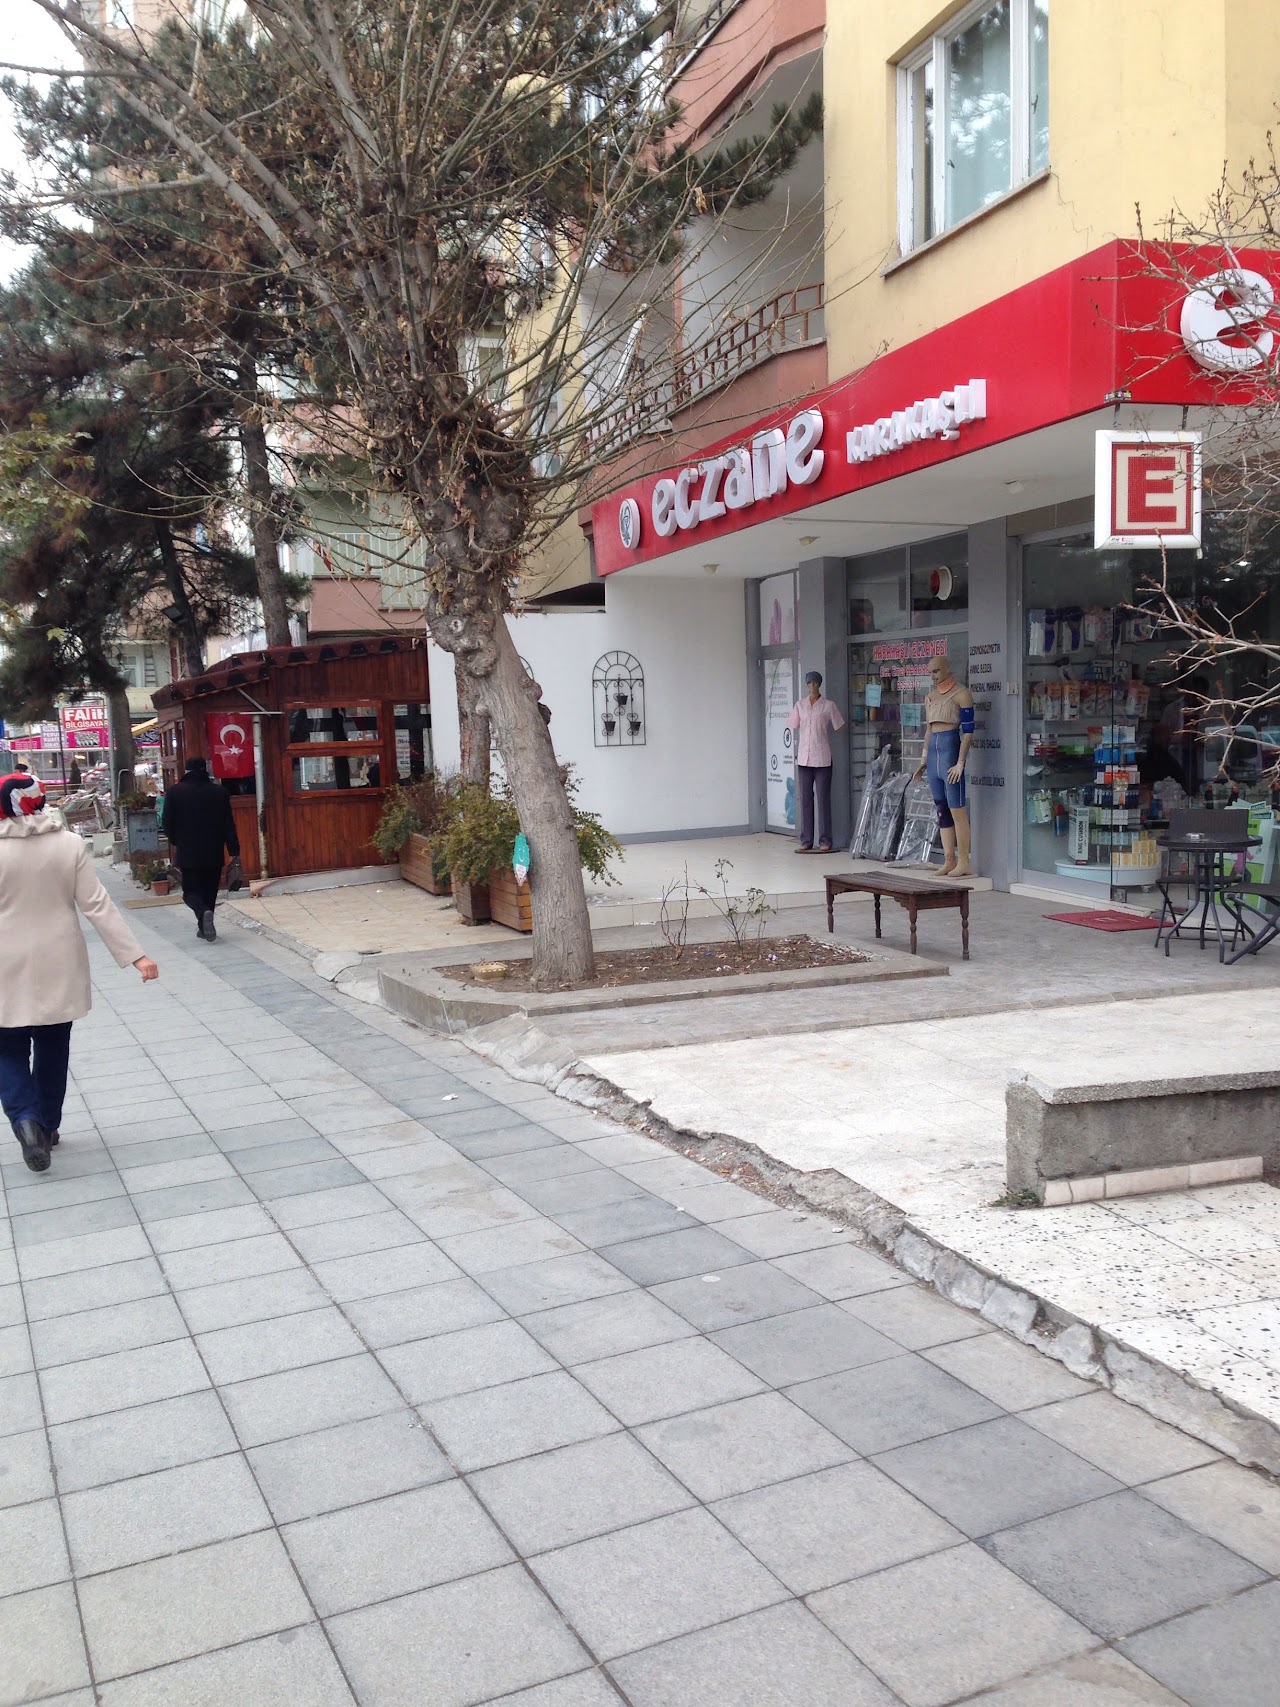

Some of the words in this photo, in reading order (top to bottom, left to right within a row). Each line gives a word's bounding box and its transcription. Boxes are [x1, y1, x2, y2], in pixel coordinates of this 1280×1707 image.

[651, 409, 824, 537] eczane
[846, 378, 987, 464] KARAKAŞLI
[1127, 456, 1177, 523] E
